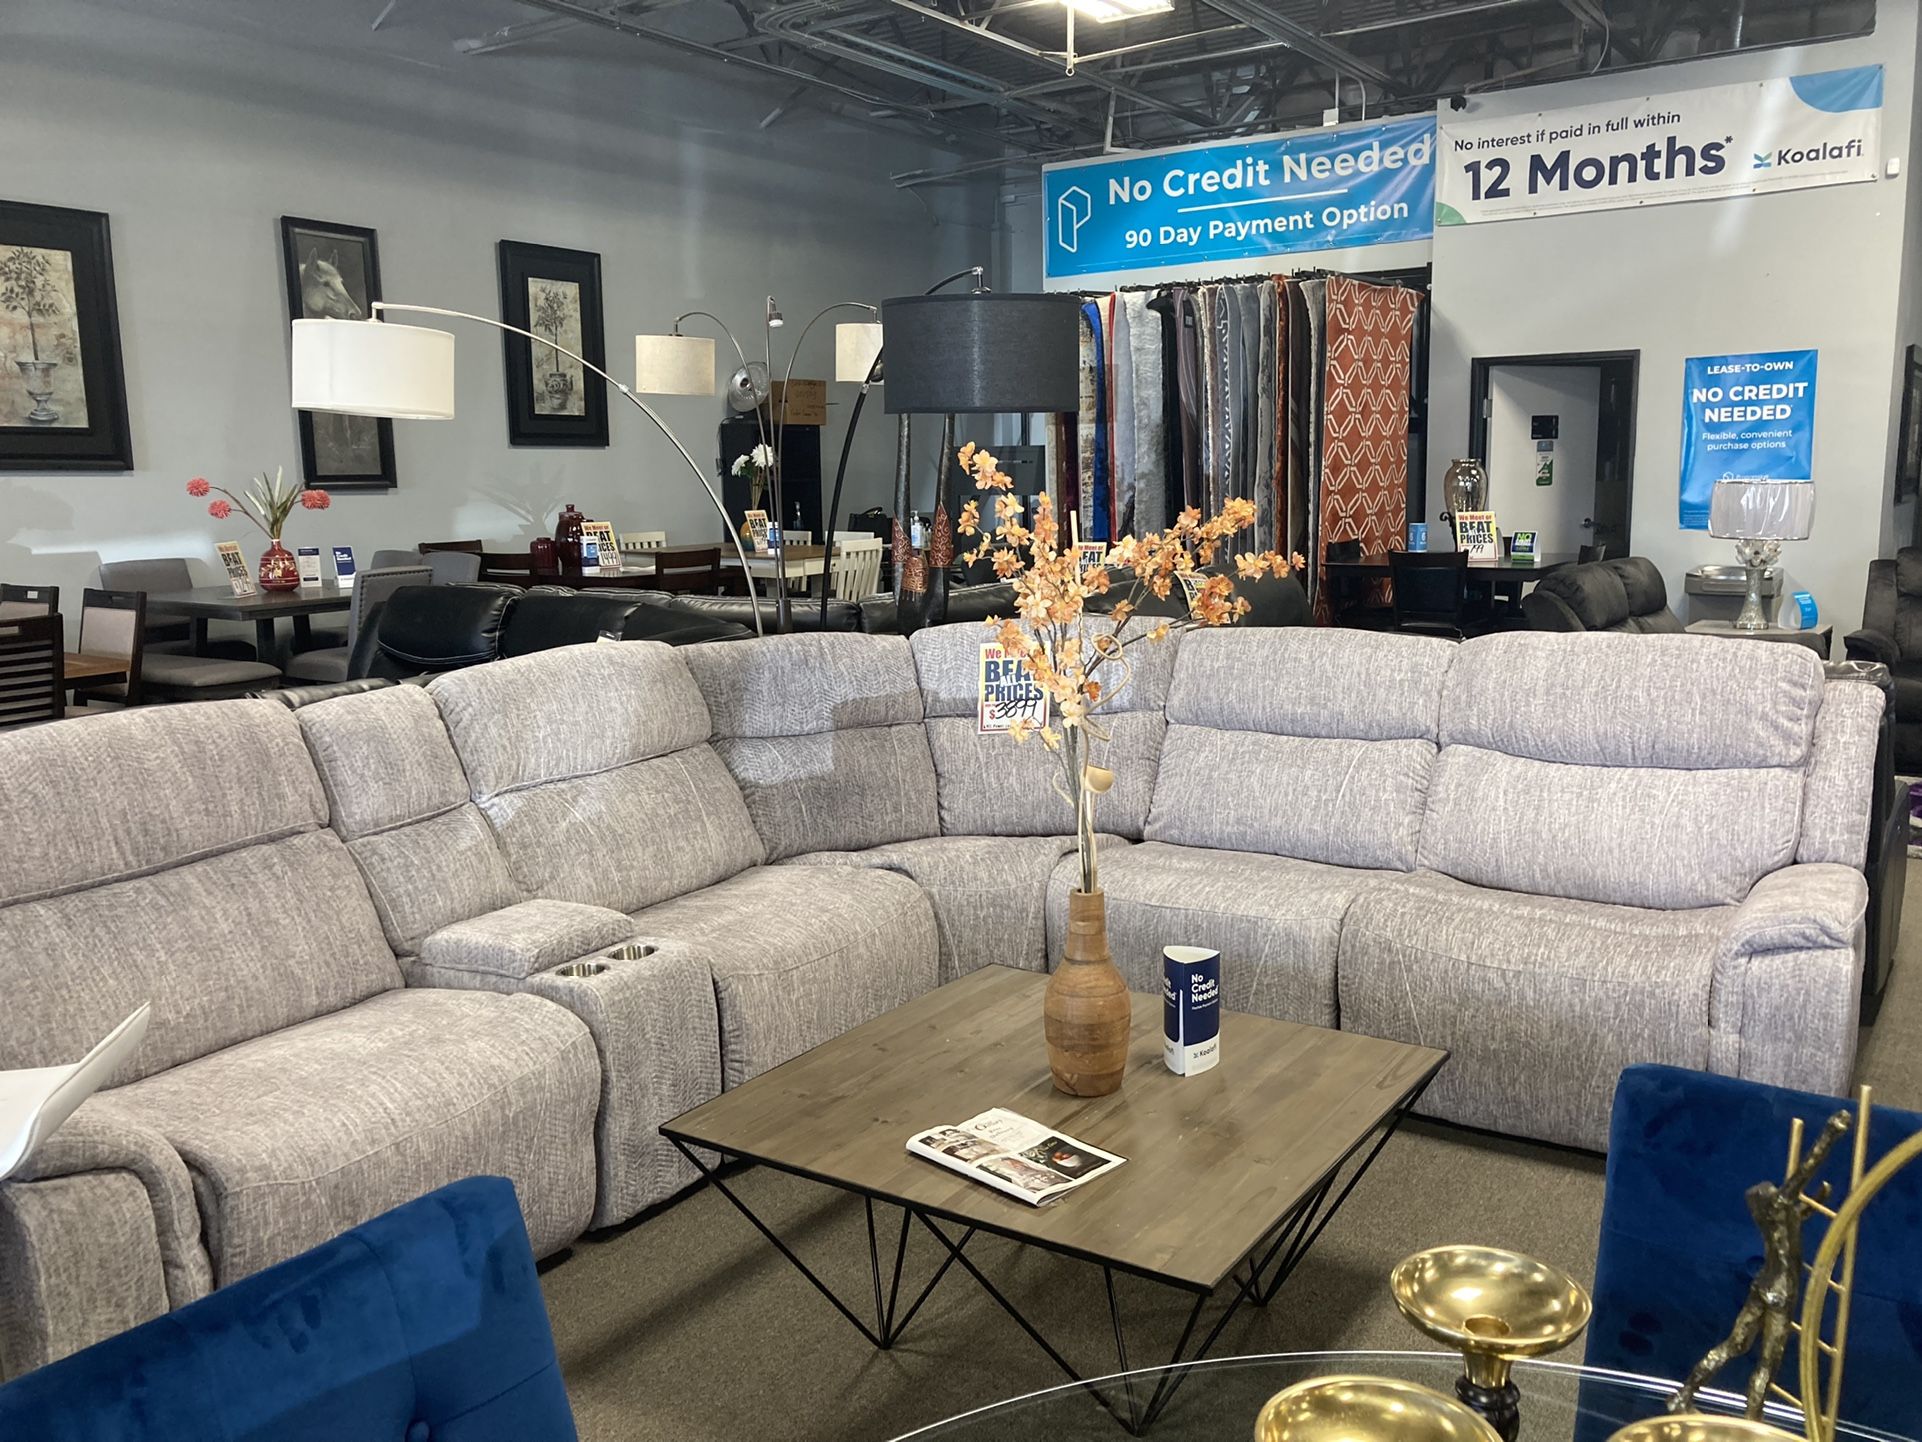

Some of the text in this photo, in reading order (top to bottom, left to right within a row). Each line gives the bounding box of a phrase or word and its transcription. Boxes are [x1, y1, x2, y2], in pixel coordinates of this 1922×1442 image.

[1454, 112, 1681, 152] No interest if paid in full within
[1776, 139, 1863, 167] Koalafi
[1108, 133, 1431, 205] No Credit Needed
[1463, 157, 1511, 201] 12
[1125, 200, 1409, 249] 90 Day Payment Option
[1707, 361, 1794, 375] LEASE-TO-OWN
[1692, 382, 1809, 403] NO CREDIT
[1704, 404, 1792, 423] NEEDED
[1702, 430, 1792, 441] Flexible, convenient
[1707, 441, 1786, 452] purchase options
[1459, 521, 1493, 533] BEAT
[1460, 533, 1494, 544] PRICES
[221, 552, 243, 567] BEAT
[985, 648, 1001, 659] We
[985, 660, 1036, 683] BEA
[984, 683, 1044, 702] PRICES
[1191, 973, 1204, 984] No
[1191, 979, 1215, 993] Credit
[1191, 983, 1219, 1003] Needed
